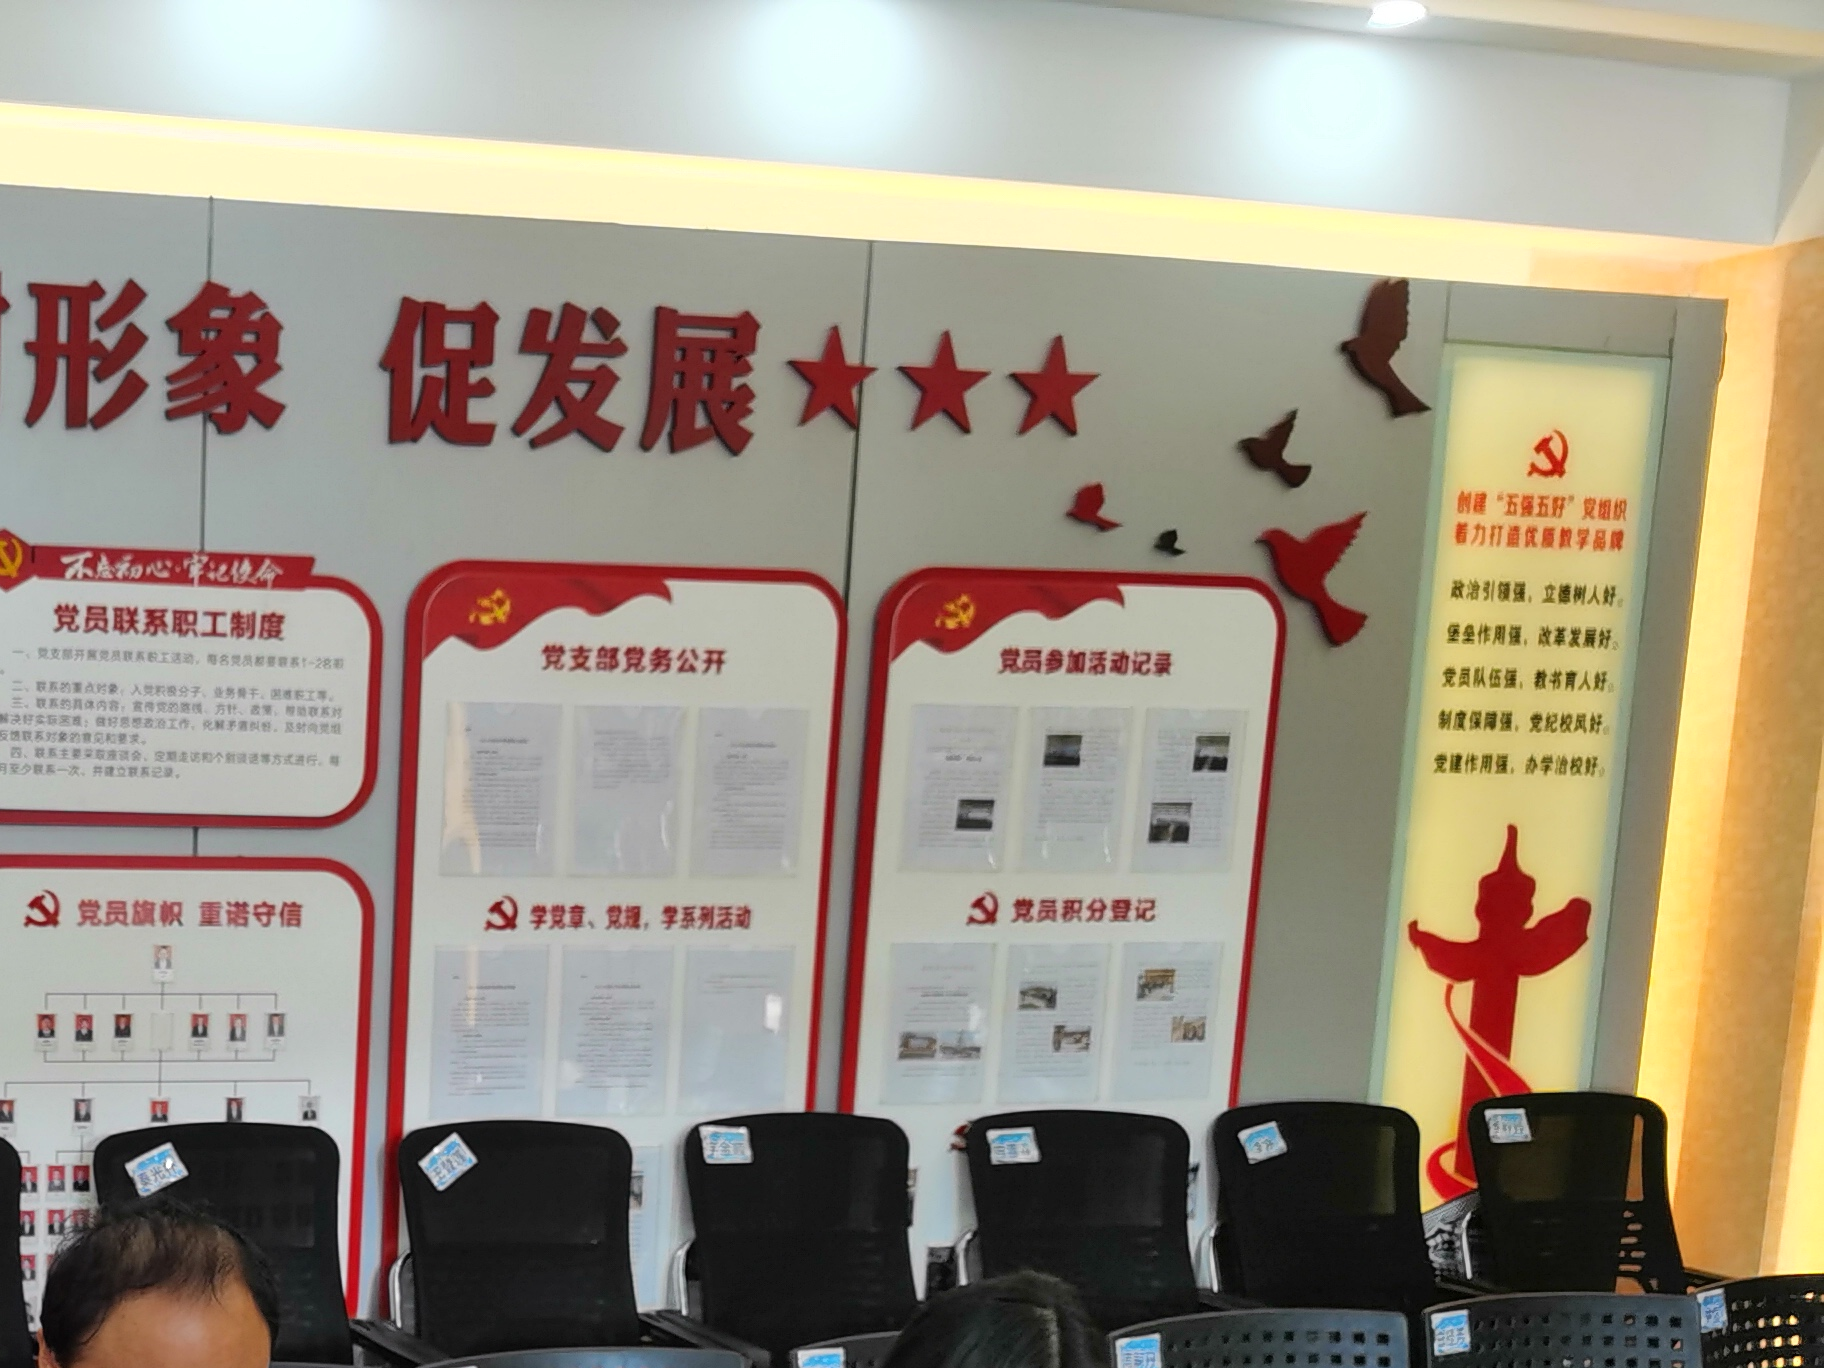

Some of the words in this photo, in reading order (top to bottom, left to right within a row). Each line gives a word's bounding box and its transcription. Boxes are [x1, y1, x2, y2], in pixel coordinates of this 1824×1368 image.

[378, 294, 763, 458] 促发展
[53, 603, 285, 641] 党员联系职工制度
[541, 643, 727, 676] 党支部党务公开
[997, 647, 1174, 678] 党员参加活动记录
[76, 899, 184, 928] 党员旗帜
[198, 900, 304, 929] 重诺守信
[1010, 897, 1157, 923] 党员积分登记
